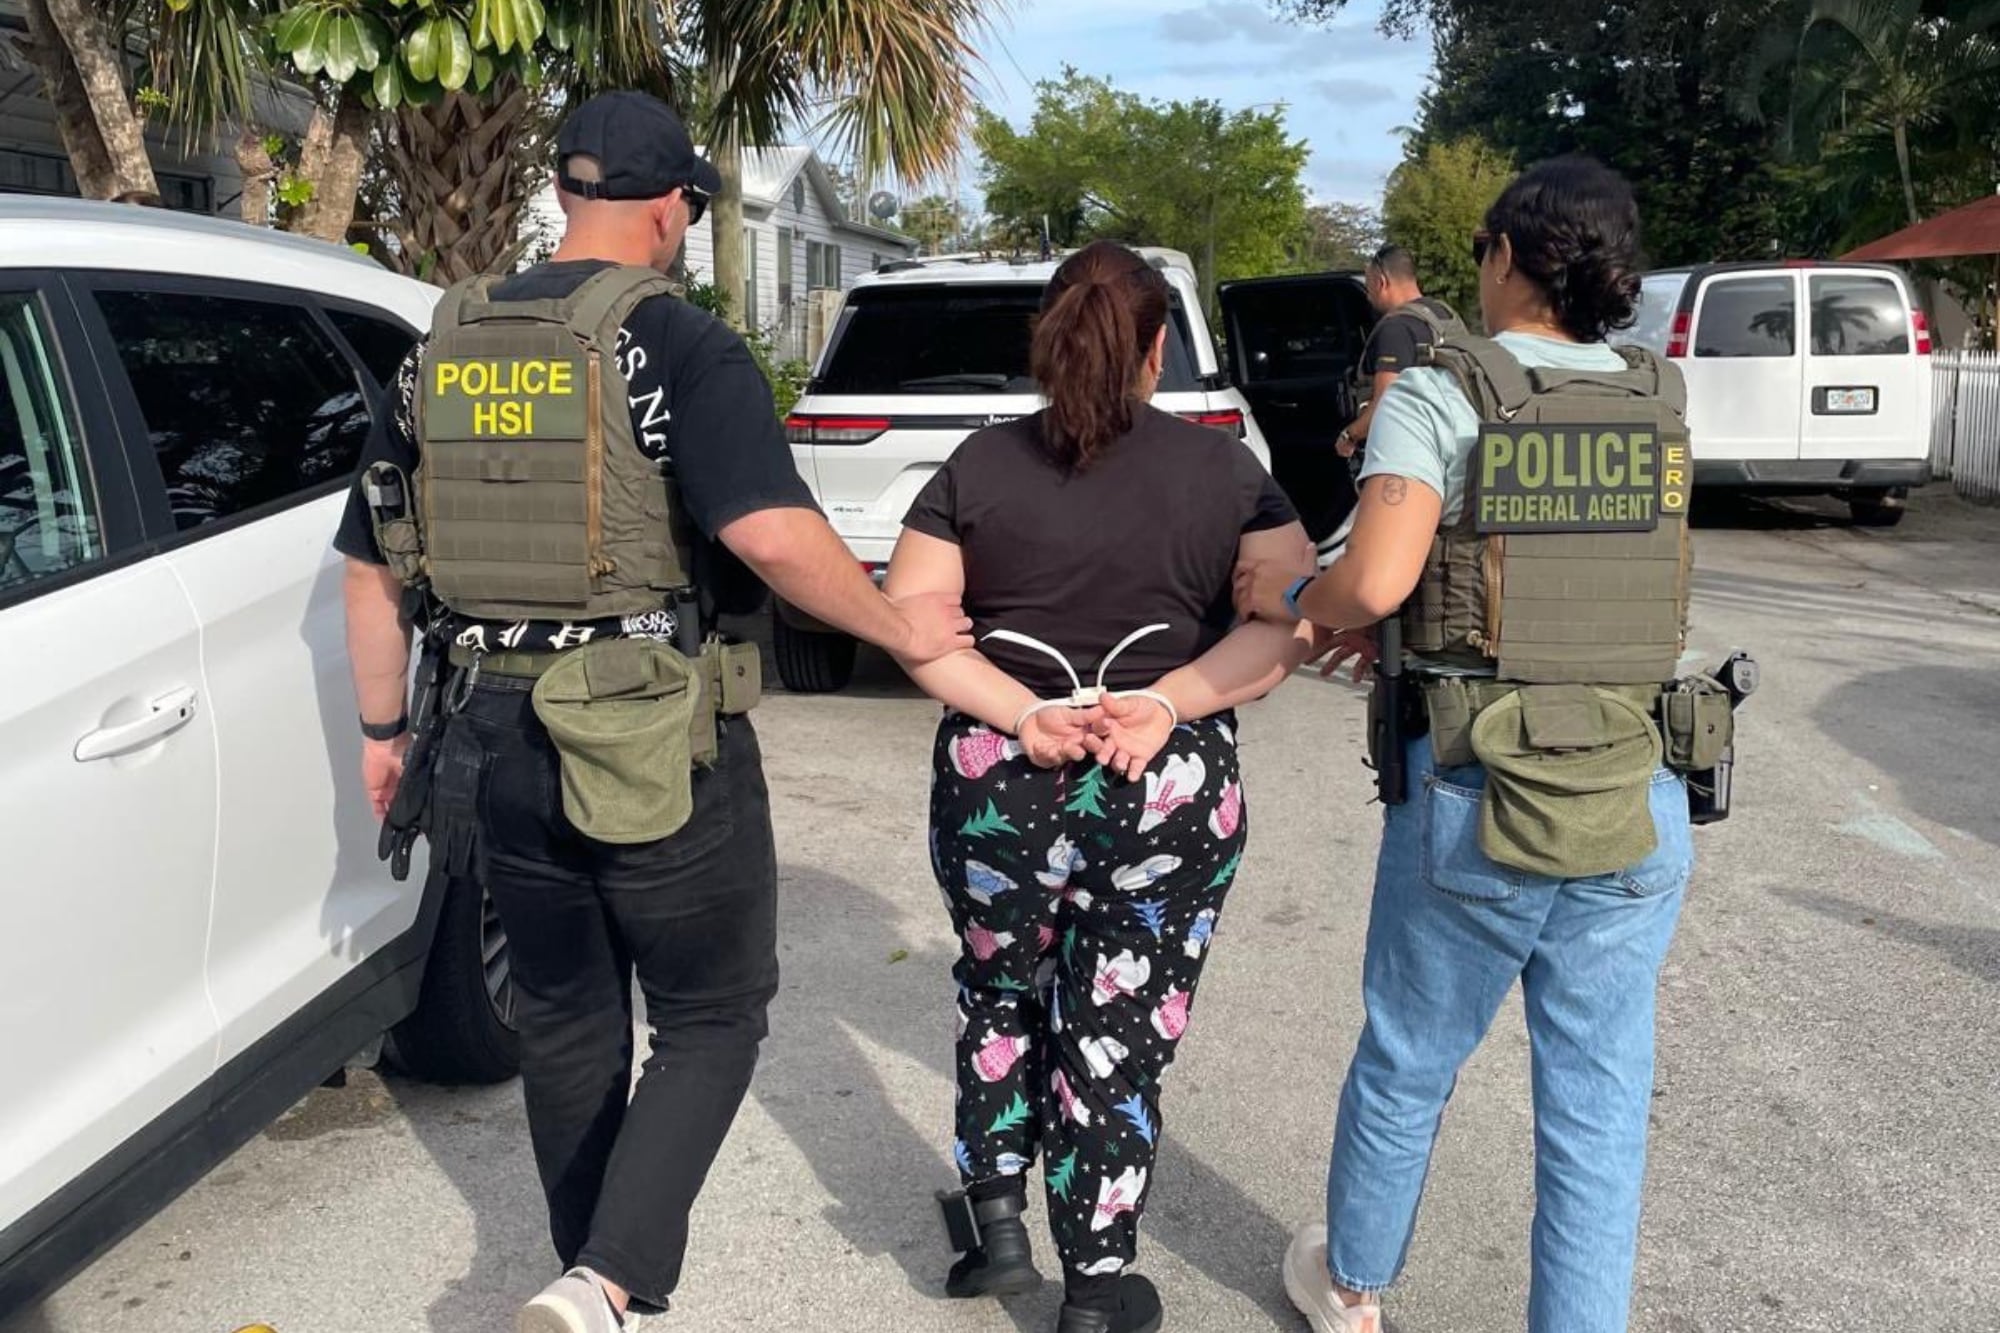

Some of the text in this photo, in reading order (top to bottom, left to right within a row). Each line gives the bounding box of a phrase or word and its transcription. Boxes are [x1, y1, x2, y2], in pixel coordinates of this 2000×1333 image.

[436, 361, 572, 396] POLICE
[474, 401, 533, 435] HSI
[1481, 432, 1654, 489] POLICE
[1663, 446, 1685, 508] ERO
[1480, 493, 1654, 523] FEDERAL AGENT
